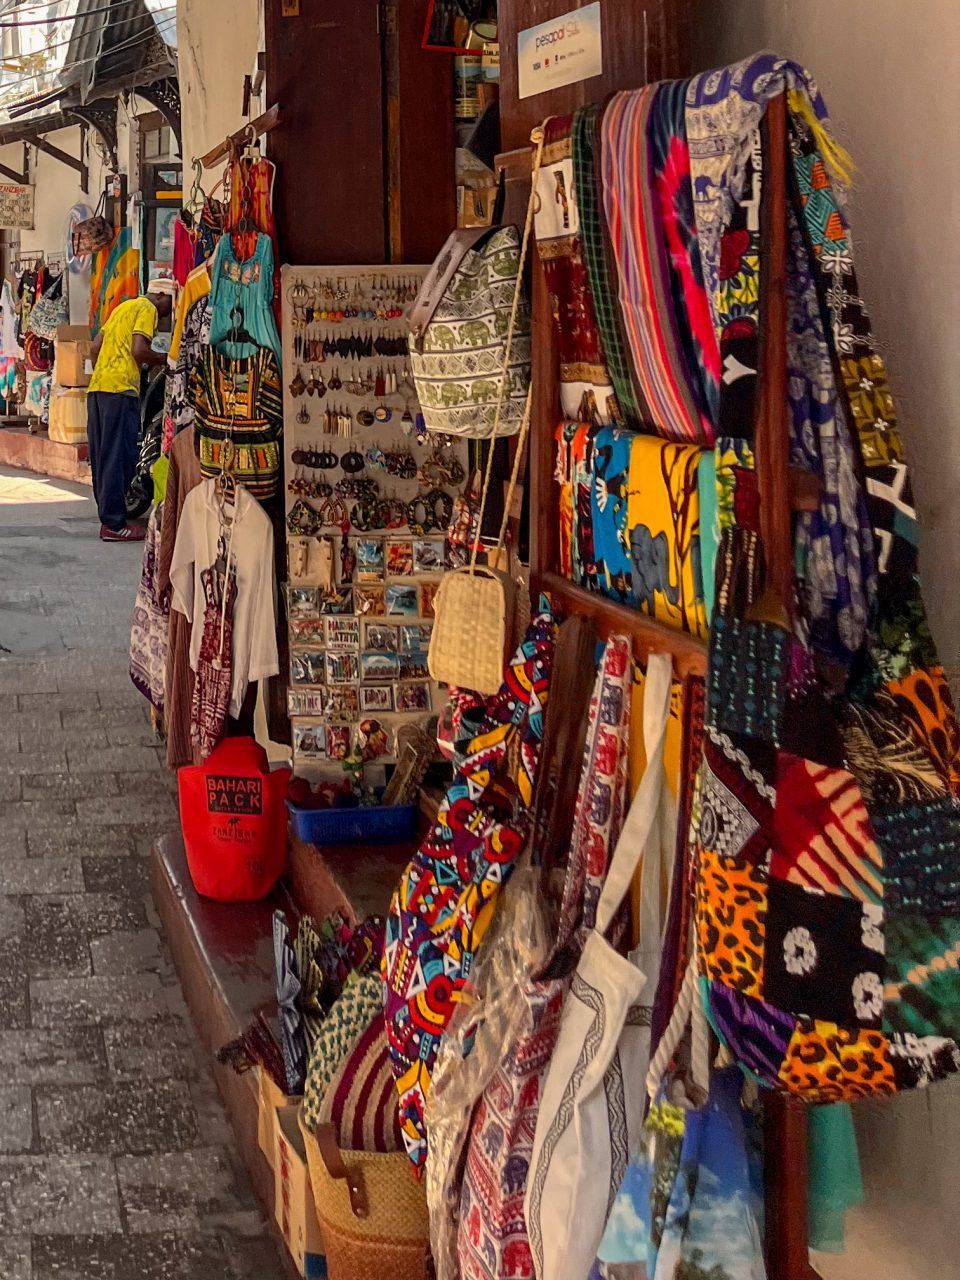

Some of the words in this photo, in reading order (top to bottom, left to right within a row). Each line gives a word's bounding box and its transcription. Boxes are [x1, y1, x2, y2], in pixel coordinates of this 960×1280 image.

[535, 23, 565, 53] pesapal
[208, 778, 260, 793] BAHARI
[209, 792, 260, 807] PACK
